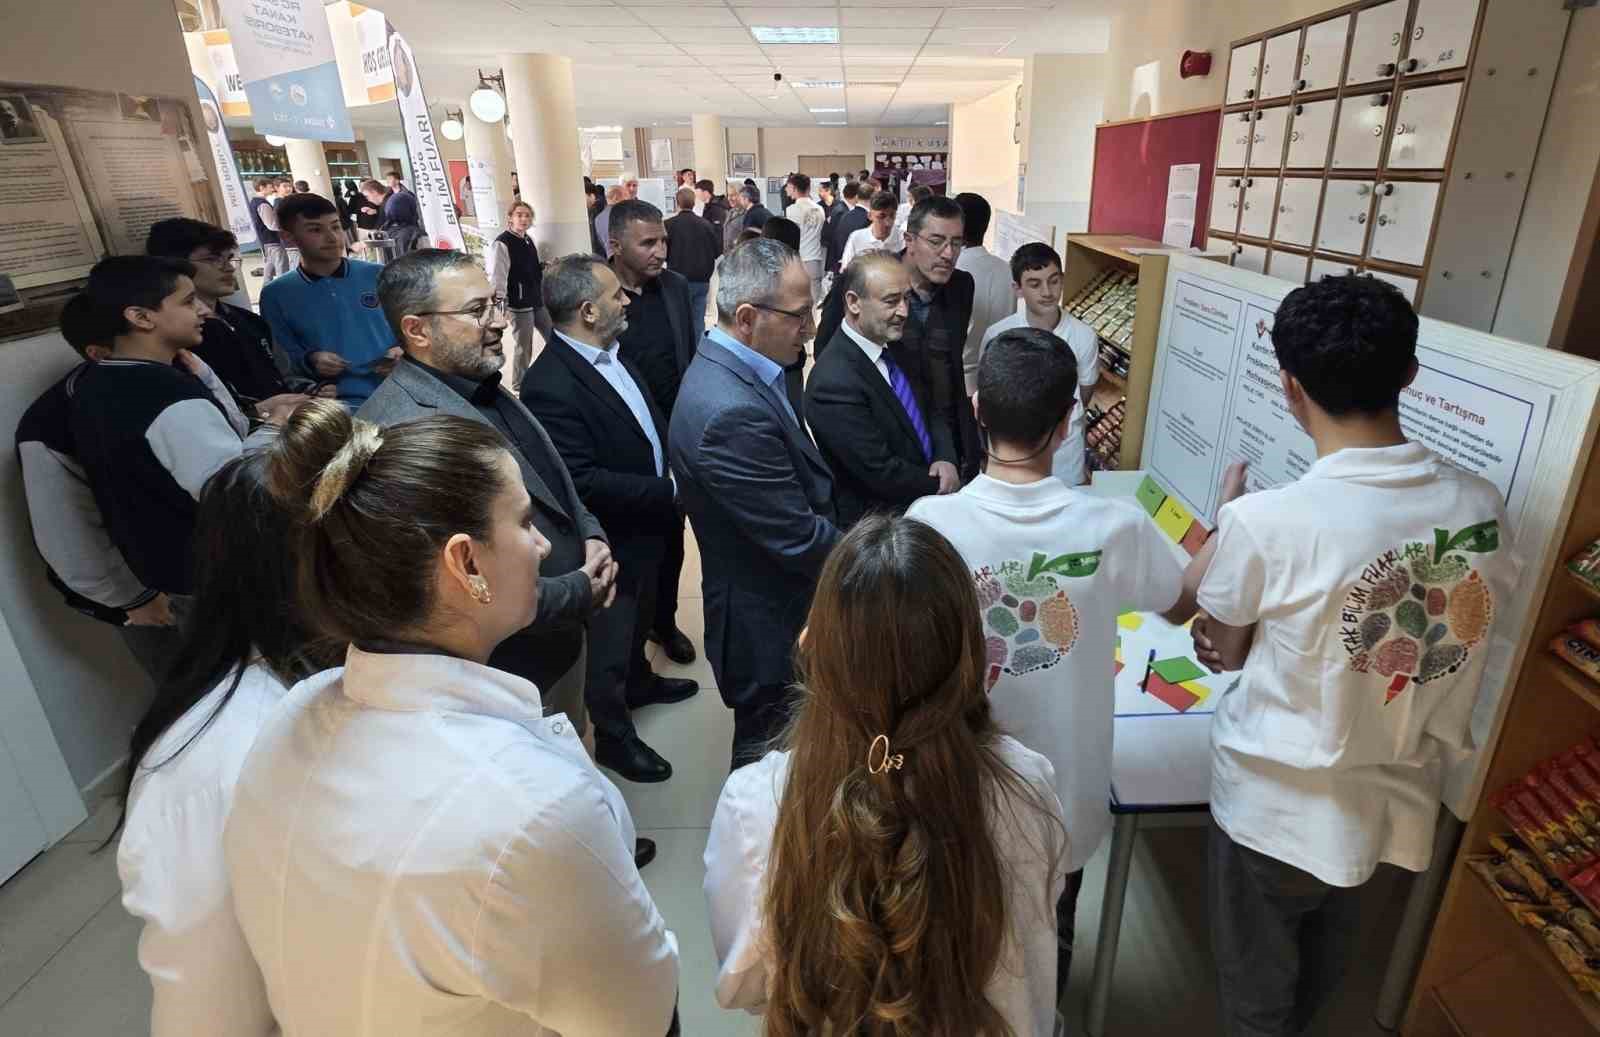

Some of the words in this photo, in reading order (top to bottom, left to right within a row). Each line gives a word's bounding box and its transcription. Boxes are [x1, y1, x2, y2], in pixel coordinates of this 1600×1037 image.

[416, 114, 441, 172] FUARI
[1424, 393, 1437, 405] ve
[1438, 396, 1486, 426] Tartışma
[1341, 586, 1371, 623] BİLİM
